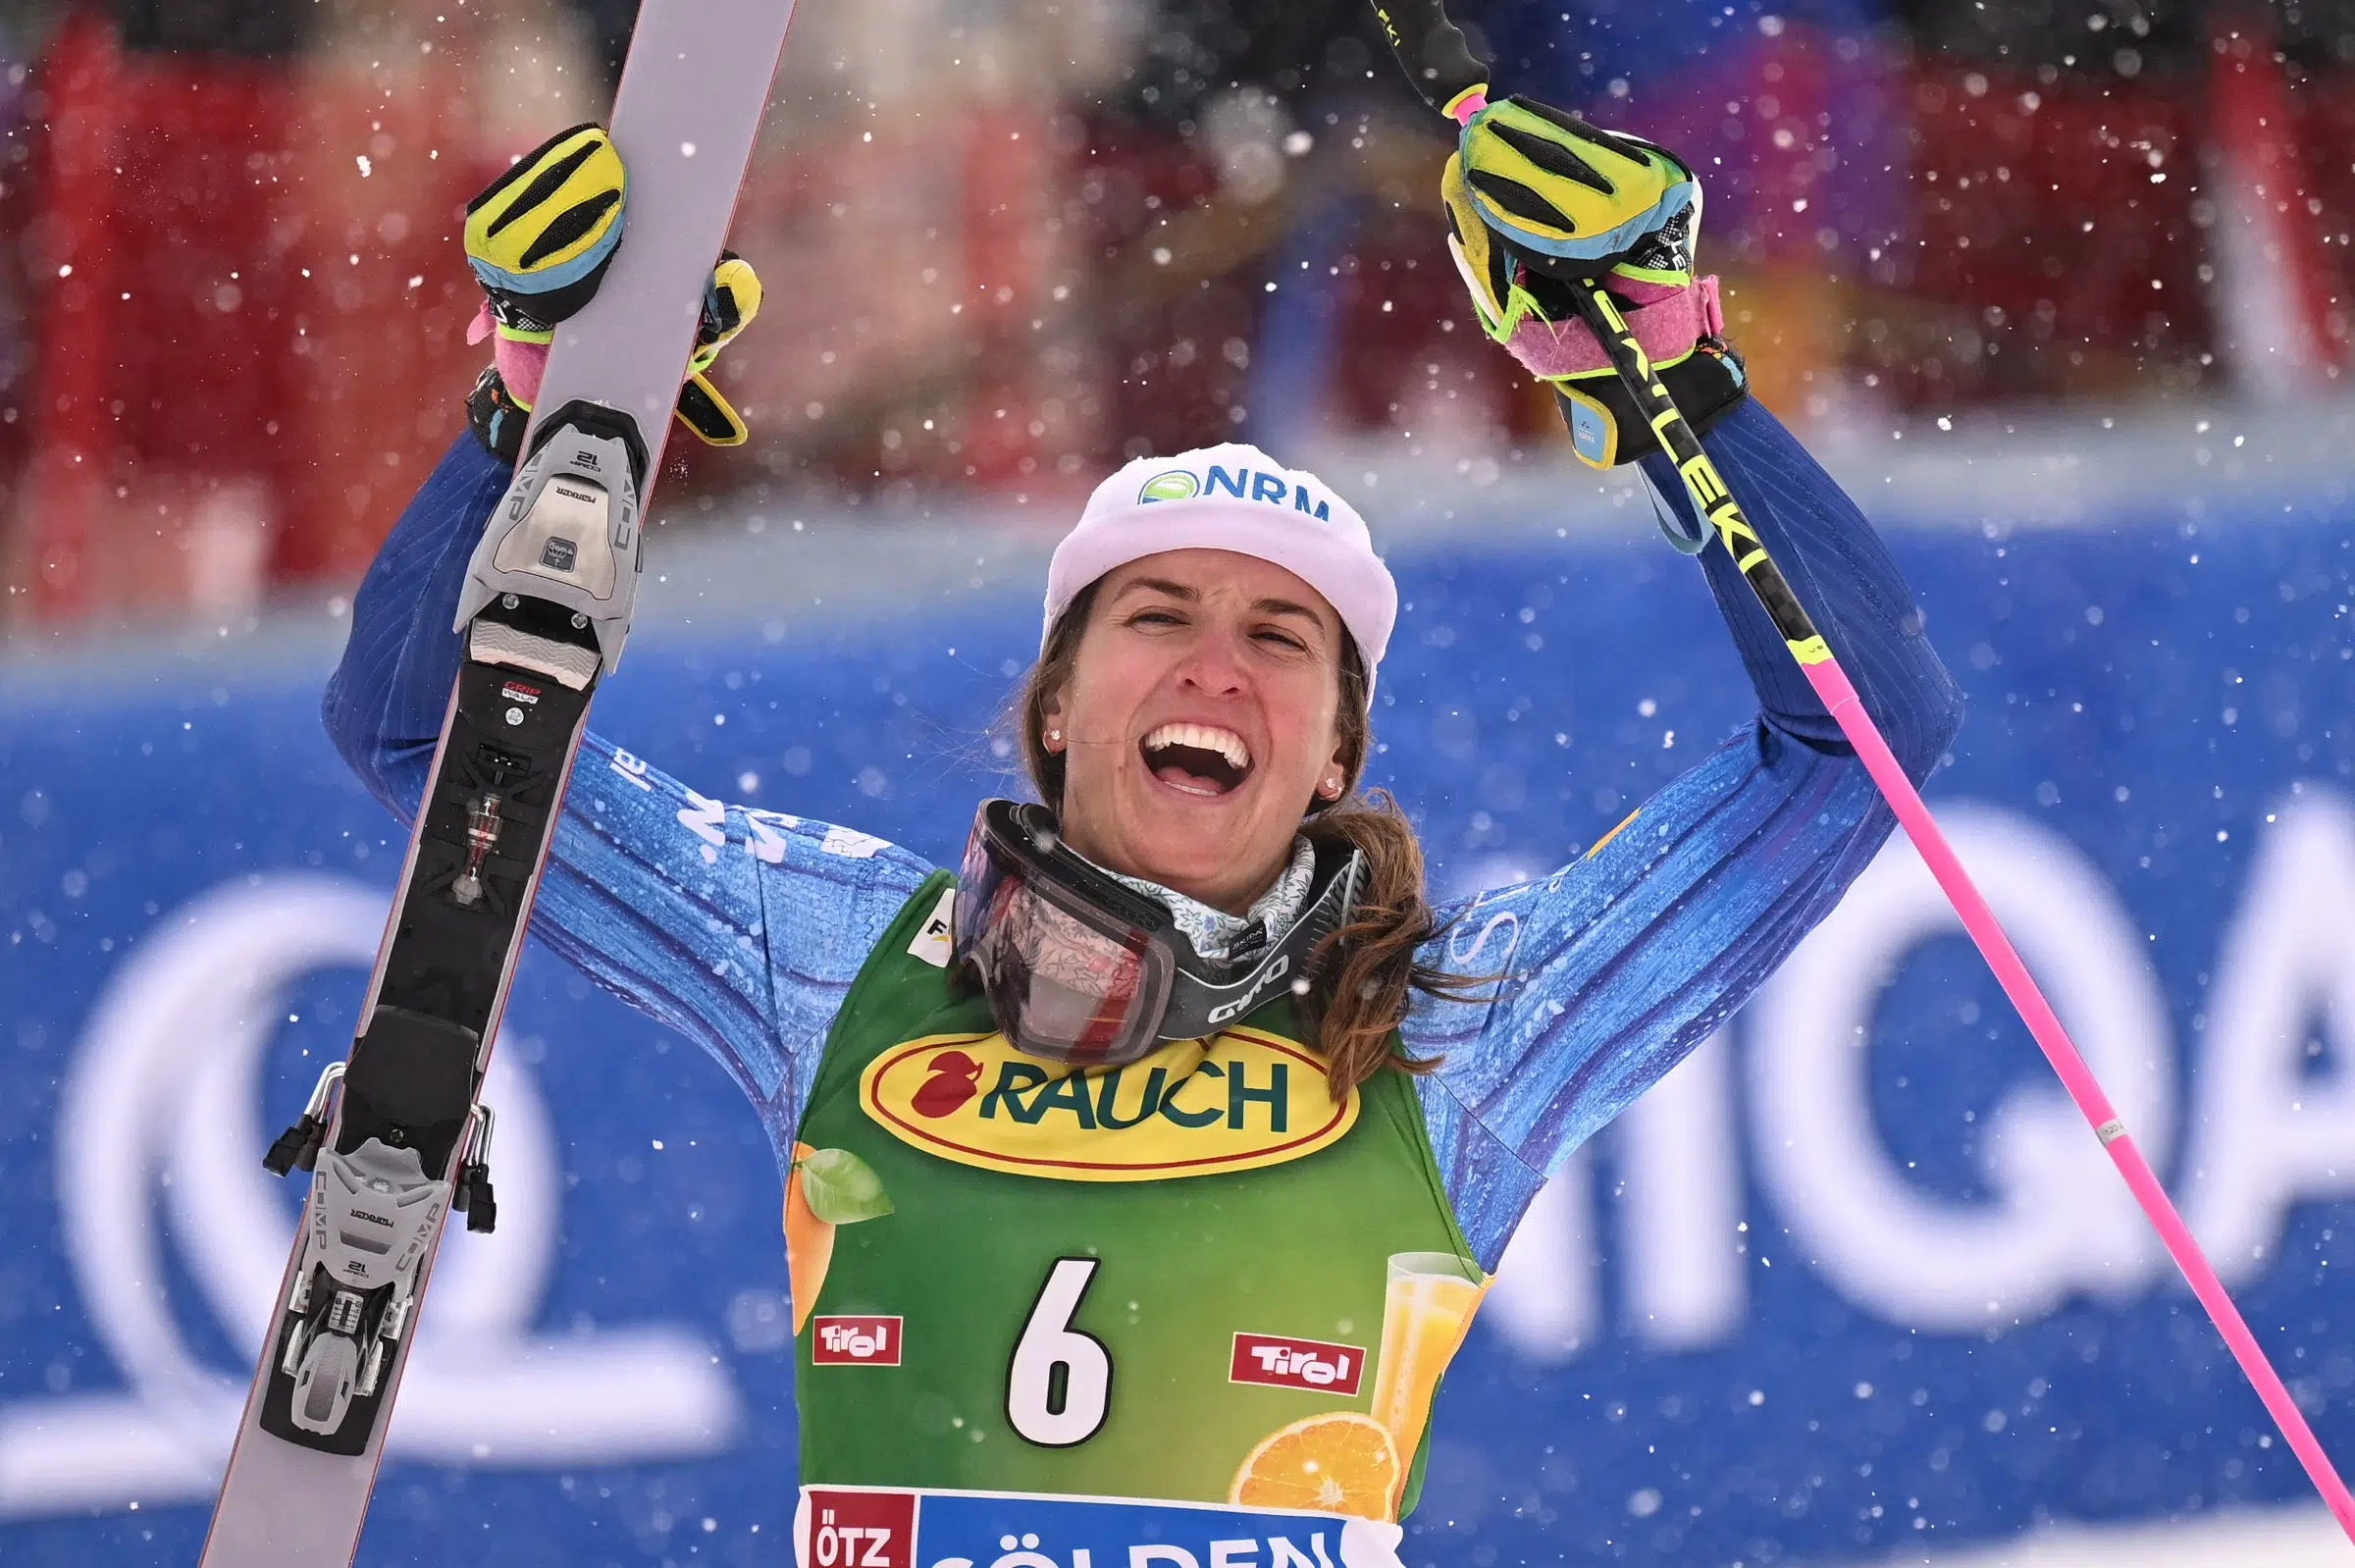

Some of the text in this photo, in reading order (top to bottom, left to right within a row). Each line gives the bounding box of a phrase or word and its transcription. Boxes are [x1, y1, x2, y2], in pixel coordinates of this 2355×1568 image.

[576, 450, 598, 466] 12
[1650, 409, 1768, 573] LEKI
[503, 680, 542, 697] GRIP
[978, 1061, 1288, 1133] RAUCH
[819, 1323, 887, 1355] Tirol
[1004, 1256, 1115, 1449] 6
[1250, 1345, 1349, 1386] Tirol
[815, 1509, 892, 1567] ÖTZ
